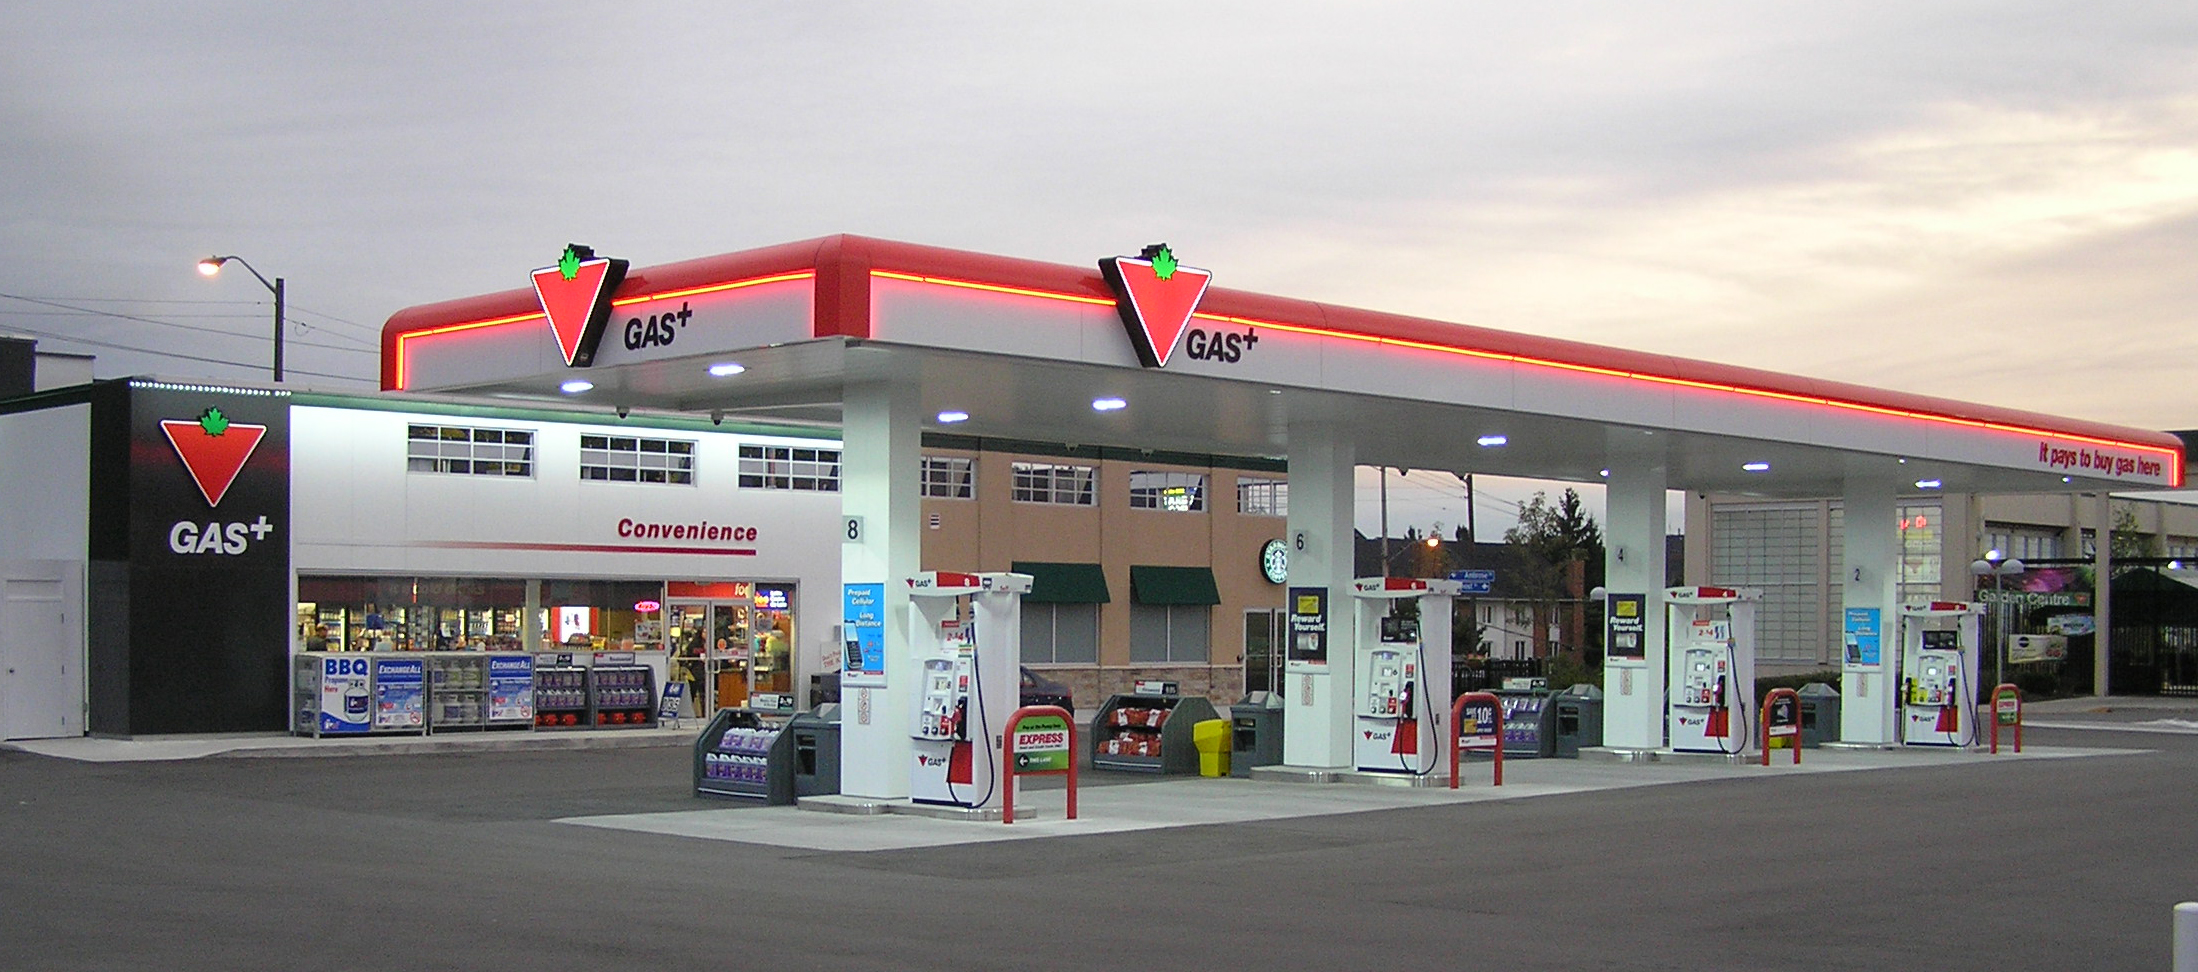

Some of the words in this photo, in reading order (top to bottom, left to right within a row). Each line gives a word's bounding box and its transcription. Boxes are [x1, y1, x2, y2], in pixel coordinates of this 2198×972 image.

[2038, 442, 2048, 463] It
[2050, 446, 2077, 469] pays
[2080, 448, 2091, 468] to
[2094, 450, 2113, 475] buy
[2116, 457, 2134, 477] gas
[2137, 456, 2161, 476] here
[618, 518, 758, 541] Convenience
[847, 519, 859, 540] 8
[1296, 533, 1304, 551] 6
[1618, 547, 1624, 562] 4
[1854, 568, 1861, 581] 2
[847, 588, 871, 597] Prepaid
[1979, 589, 2024, 604] Gaden
[2027, 592, 2070, 606] Centre
[851, 597, 874, 606] Cellular
[859, 612, 874, 620] Long
[1291, 614, 1322, 623] Reward
[1609, 616, 1640, 625] Reward
[325, 658, 369, 677] BBQ
[1019, 733, 1064, 745] EXPRESS
